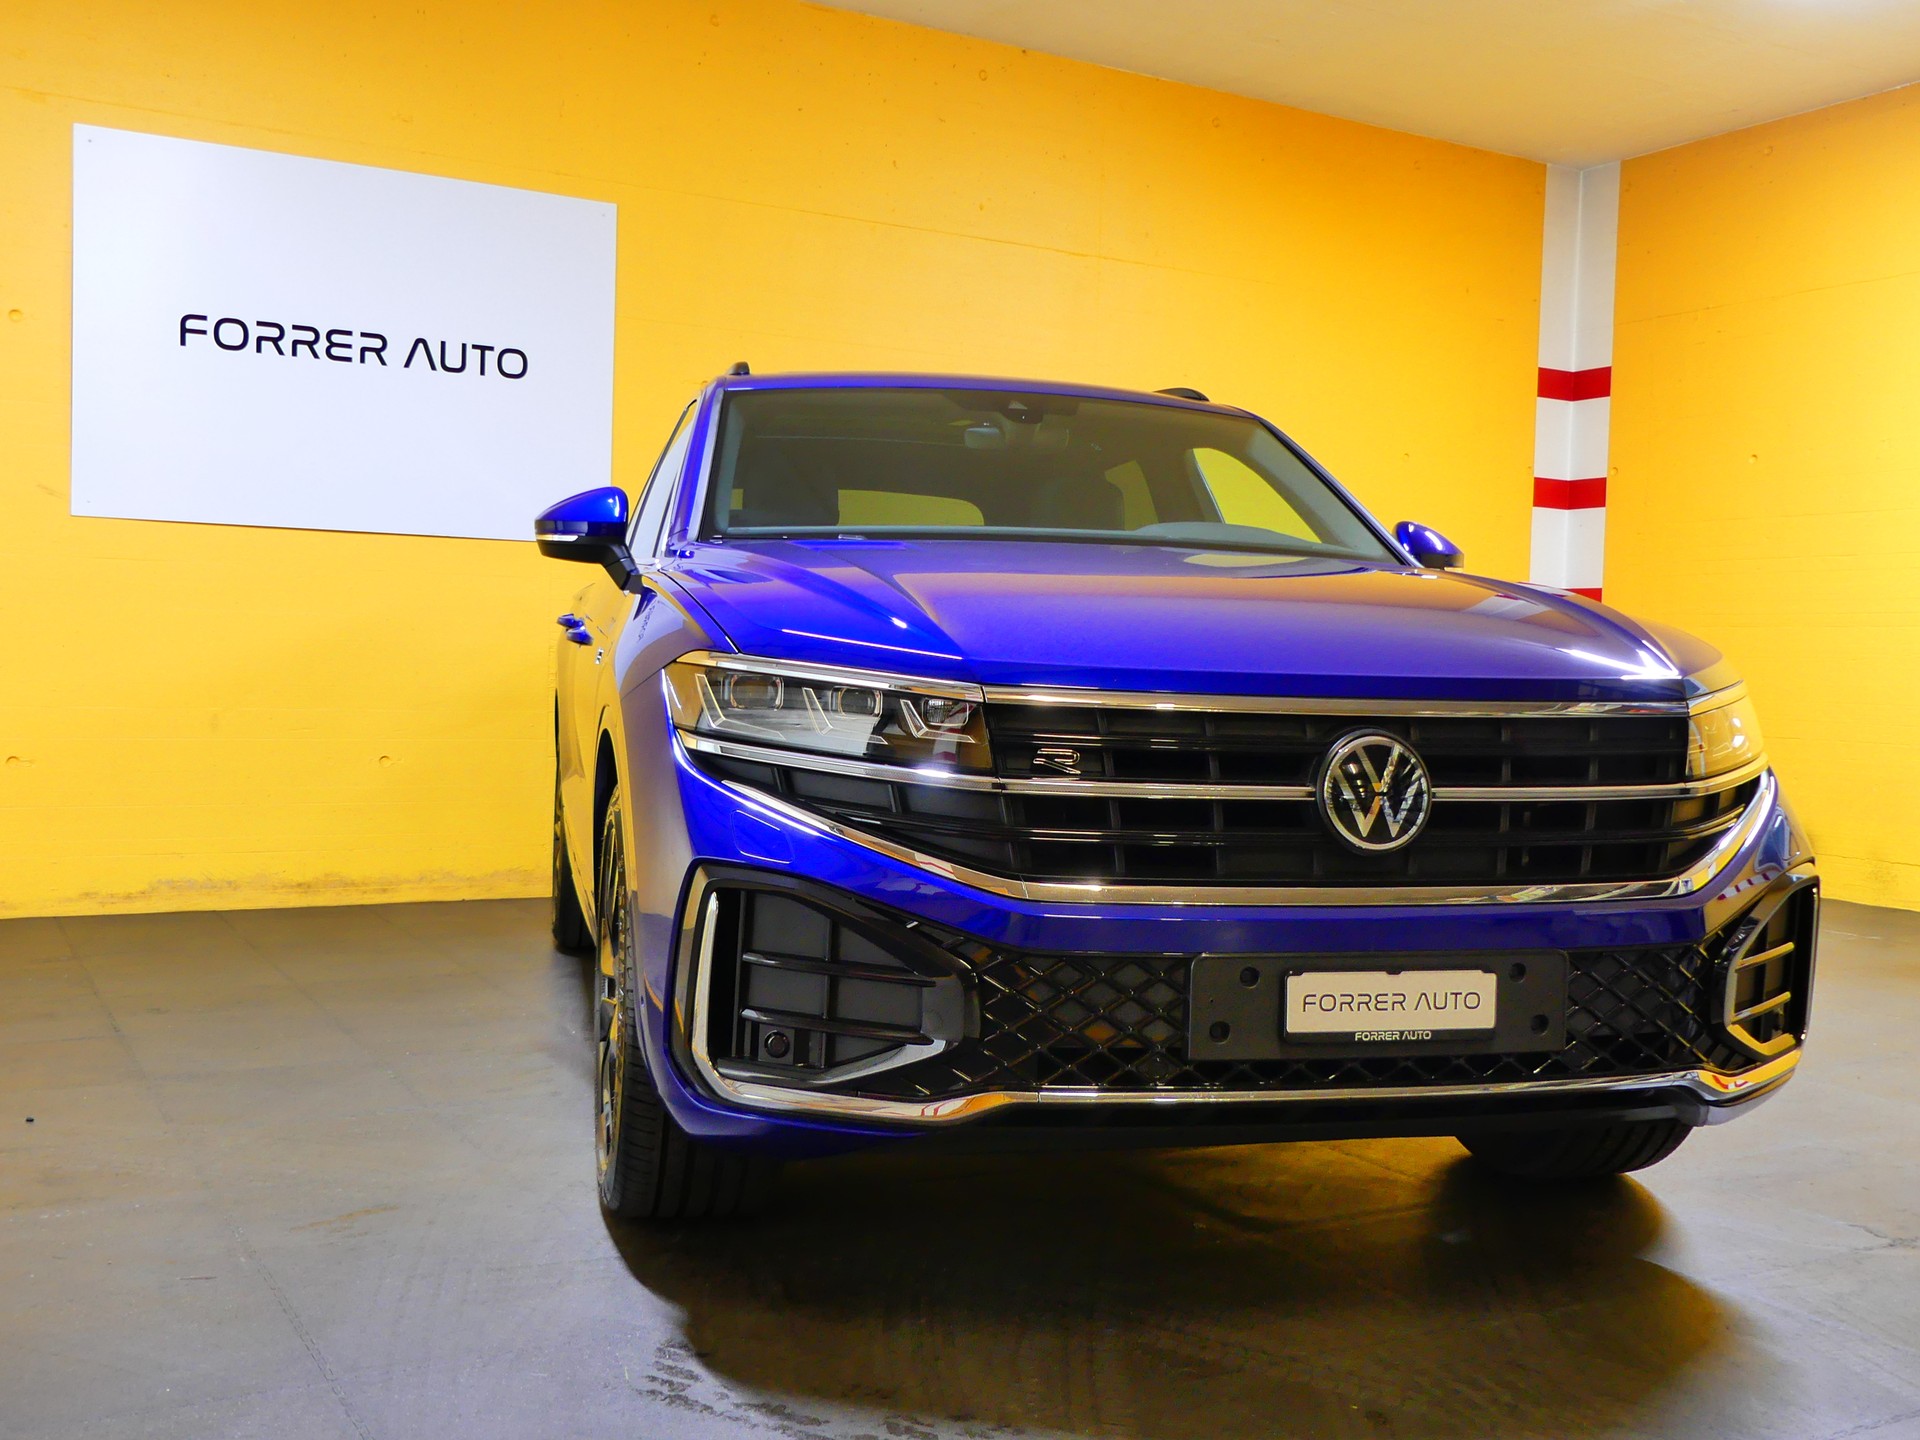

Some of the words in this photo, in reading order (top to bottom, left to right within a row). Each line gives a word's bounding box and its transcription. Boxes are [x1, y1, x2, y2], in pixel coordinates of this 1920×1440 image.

[179, 313, 388, 367] FORRER
[403, 337, 529, 380] AUTO
[1033, 747, 1082, 775] R
[1328, 738, 1424, 840] VW
[1302, 992, 1407, 1013] FORRER
[1414, 991, 1482, 1011] AUTO
[1354, 1031, 1400, 1042] FORRER
[1401, 1030, 1432, 1041] AUTO
